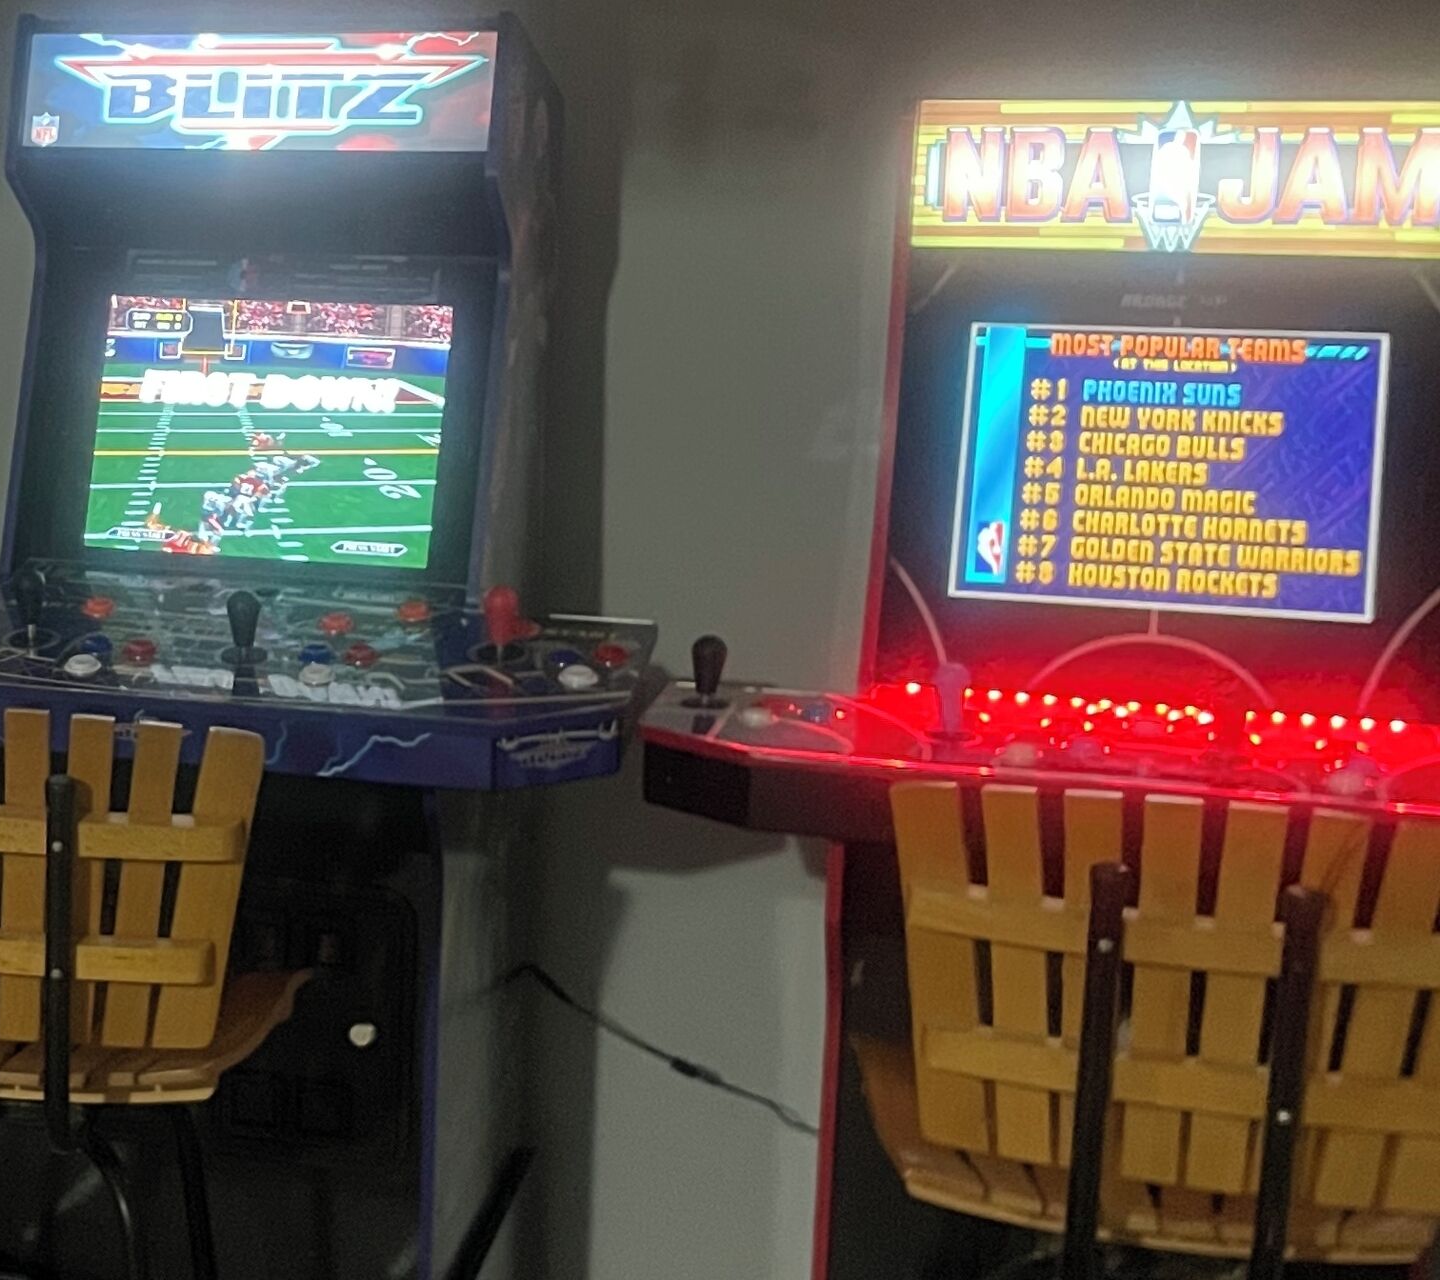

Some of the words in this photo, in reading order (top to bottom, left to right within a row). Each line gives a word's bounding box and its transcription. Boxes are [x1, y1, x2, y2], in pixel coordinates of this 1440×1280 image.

[102, 67, 424, 124] BLITZ
[943, 127, 1133, 223] NBA
[1216, 127, 1440, 225] JAM
[1050, 332, 1113, 357] MOST
[1119, 335, 1221, 360] POPULAR
[1227, 338, 1308, 364] TEAMS
[1082, 379, 1178, 405] PHOENIX
[1183, 383, 1242, 407] SUNS
[1028, 403, 1067, 427] #2
[1080, 405, 1131, 430] NEW
[1137, 407, 1197, 433] YORK
[1202, 410, 1285, 437] KNICKS
[1026, 429, 1066, 453] #3
[1078, 431, 1171, 458] CHICAGO
[1176, 434, 1246, 460] BULLS
[1024, 456, 1064, 480] #4
[1076, 457, 1118, 482] L.A.
[1123, 459, 1208, 486] LAKERS
[1022, 482, 1061, 505] #5
[1074, 483, 1176, 511] ORLANDO
[1181, 488, 1257, 515] MAGIC
[1019, 508, 1059, 532] #6
[1072, 510, 1198, 539] CHARLOTTE
[1202, 516, 1307, 544] HORNETS
[1017, 534, 1057, 558] #7
[1071, 536, 1155, 563] GOLDEN
[1160, 540, 1231, 567] STATE
[1236, 544, 1362, 577] WARRIORS
[1015, 561, 1054, 585] #8
[1068, 562, 1171, 592] HOUSTON
[1175, 569, 1279, 599] ROCKETS
